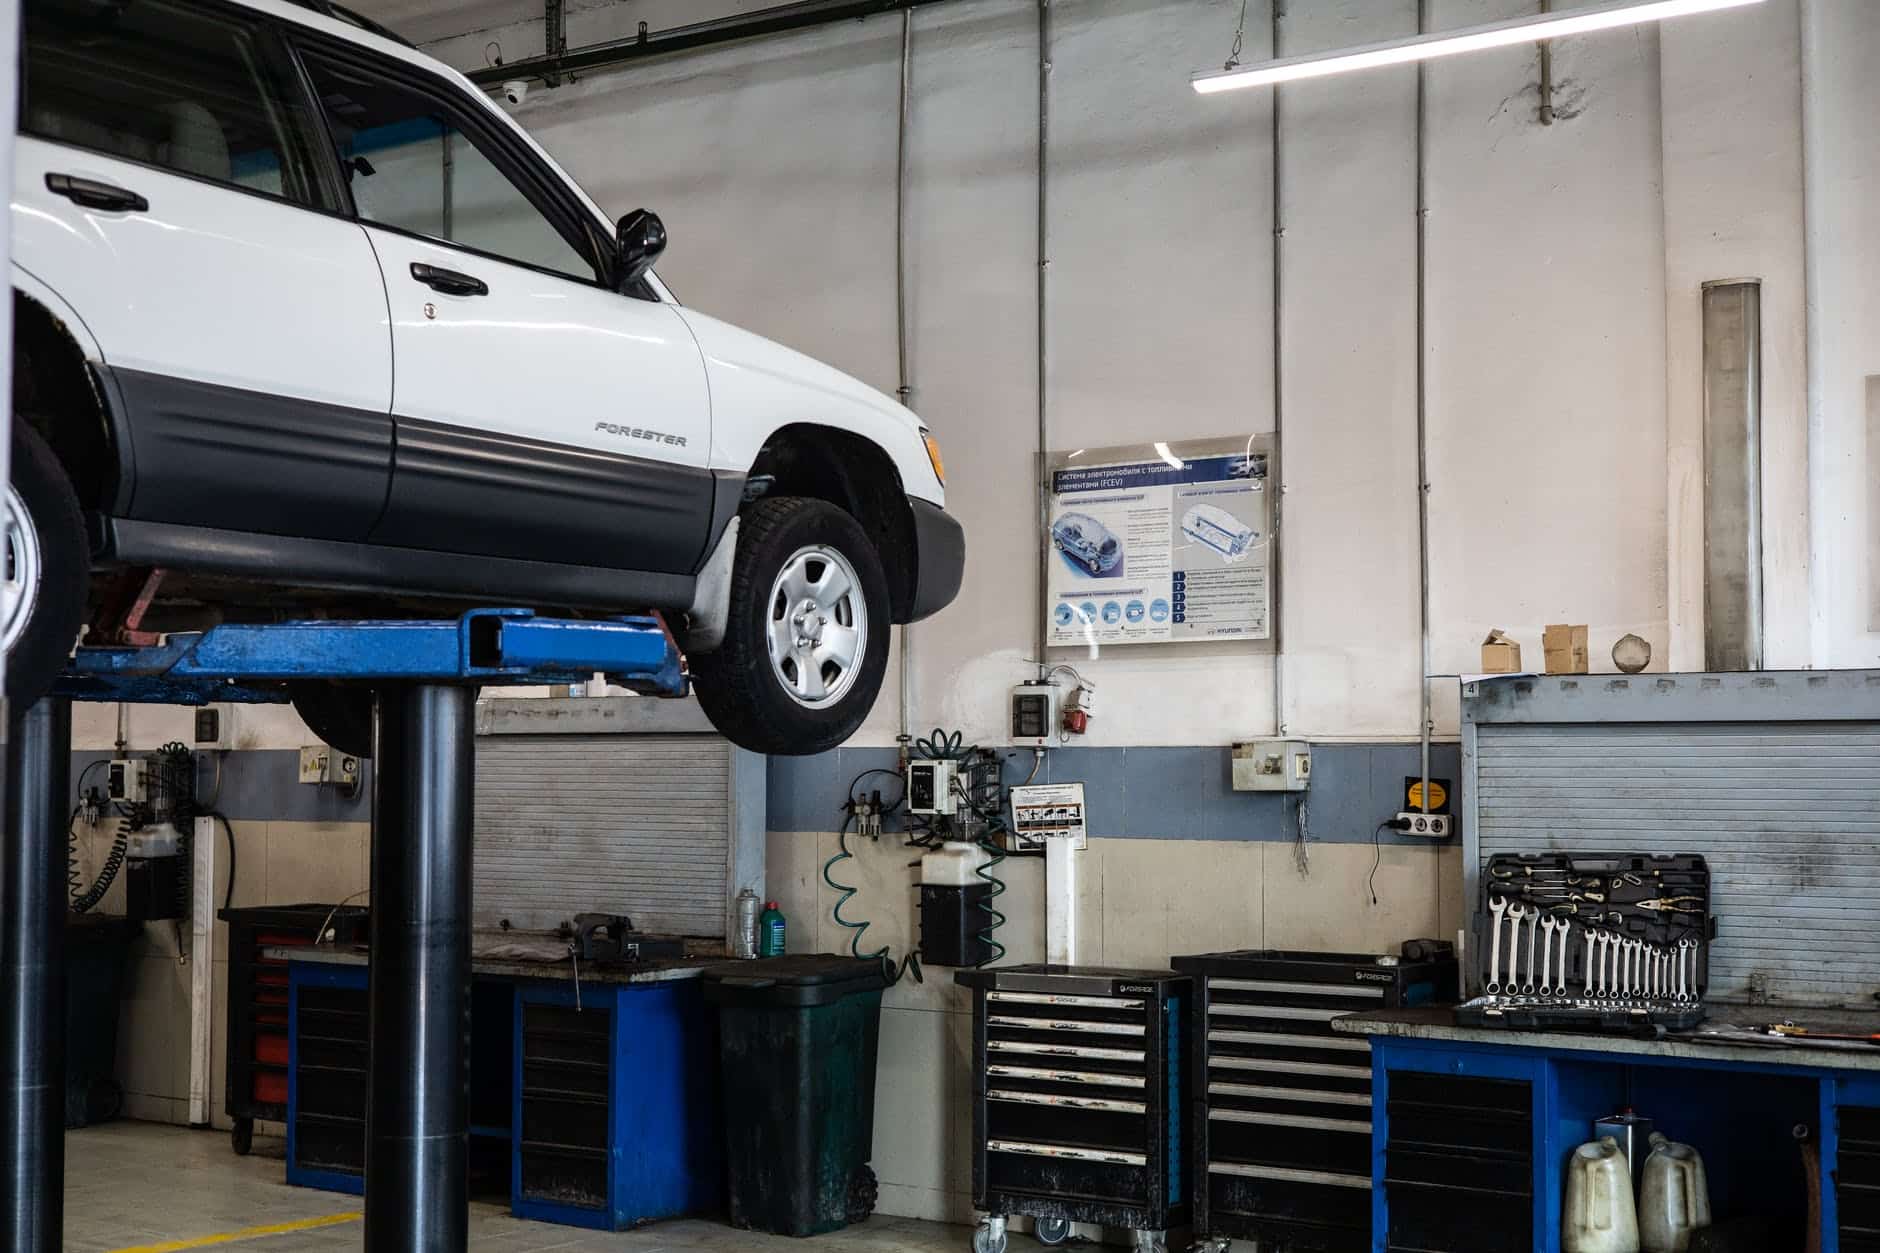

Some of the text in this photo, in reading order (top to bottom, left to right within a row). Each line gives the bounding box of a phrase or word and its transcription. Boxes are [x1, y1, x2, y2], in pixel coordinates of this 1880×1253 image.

[594, 421, 688, 448] FORESTER
[1058, 472, 1086, 481] Система
[1087, 467, 1141, 480] электромобиля
